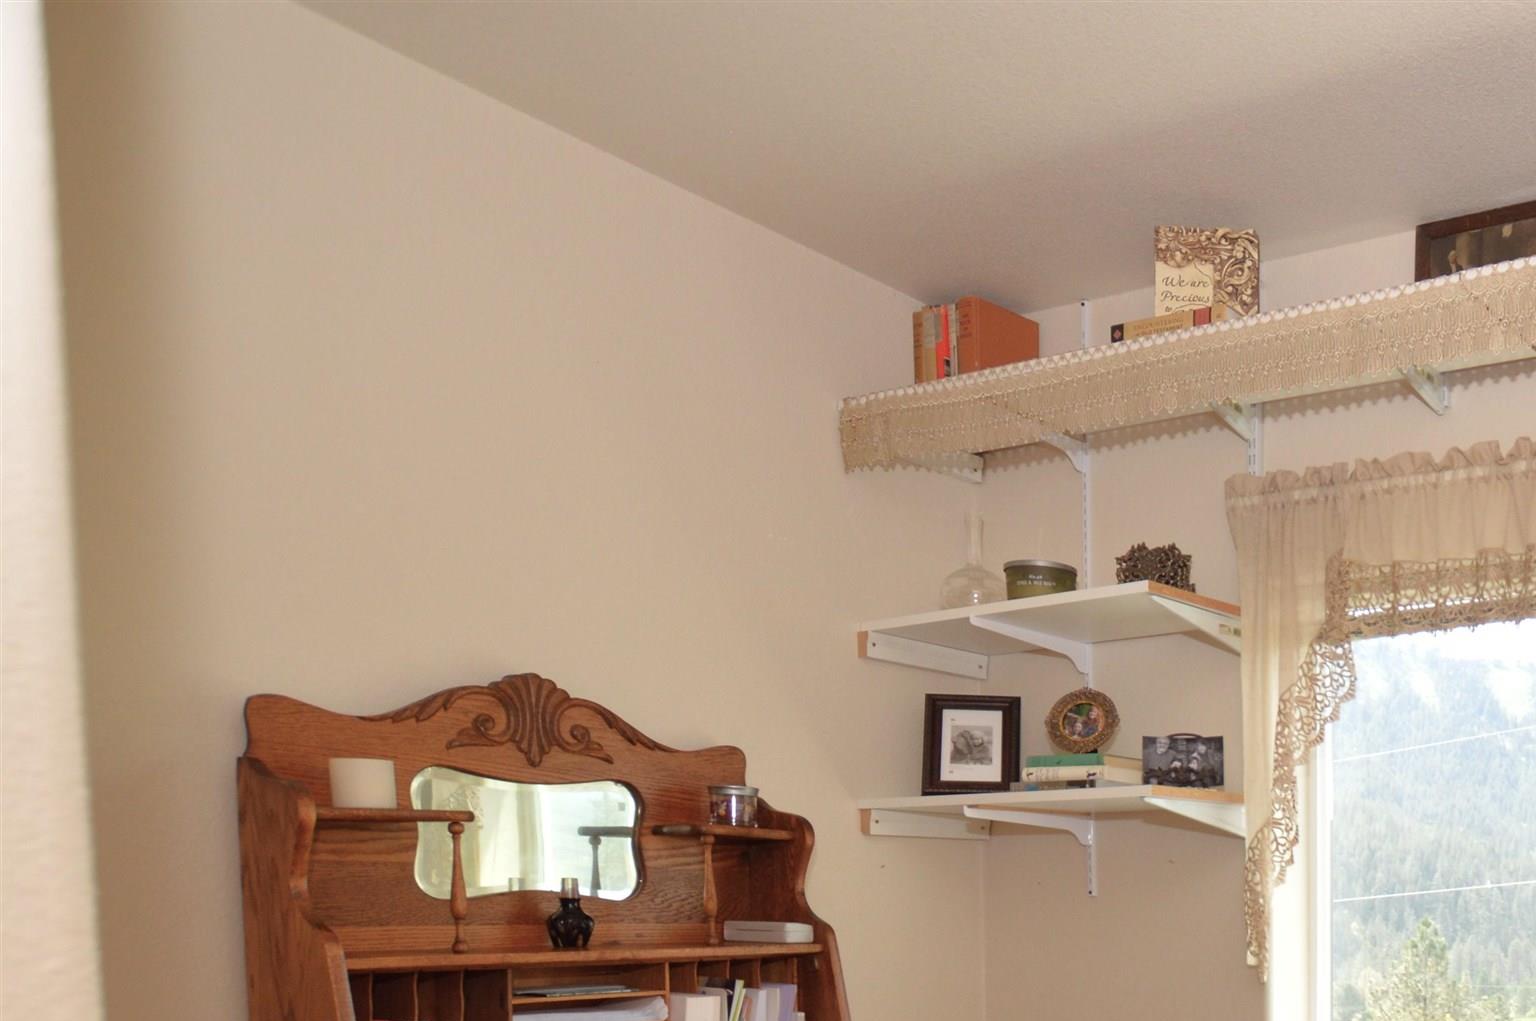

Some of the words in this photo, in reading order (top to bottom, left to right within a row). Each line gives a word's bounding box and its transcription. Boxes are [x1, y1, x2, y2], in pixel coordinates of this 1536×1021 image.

[1162, 274, 1186, 288] We
[1190, 279, 1210, 288] are
[1160, 290, 1210, 304] Precious
